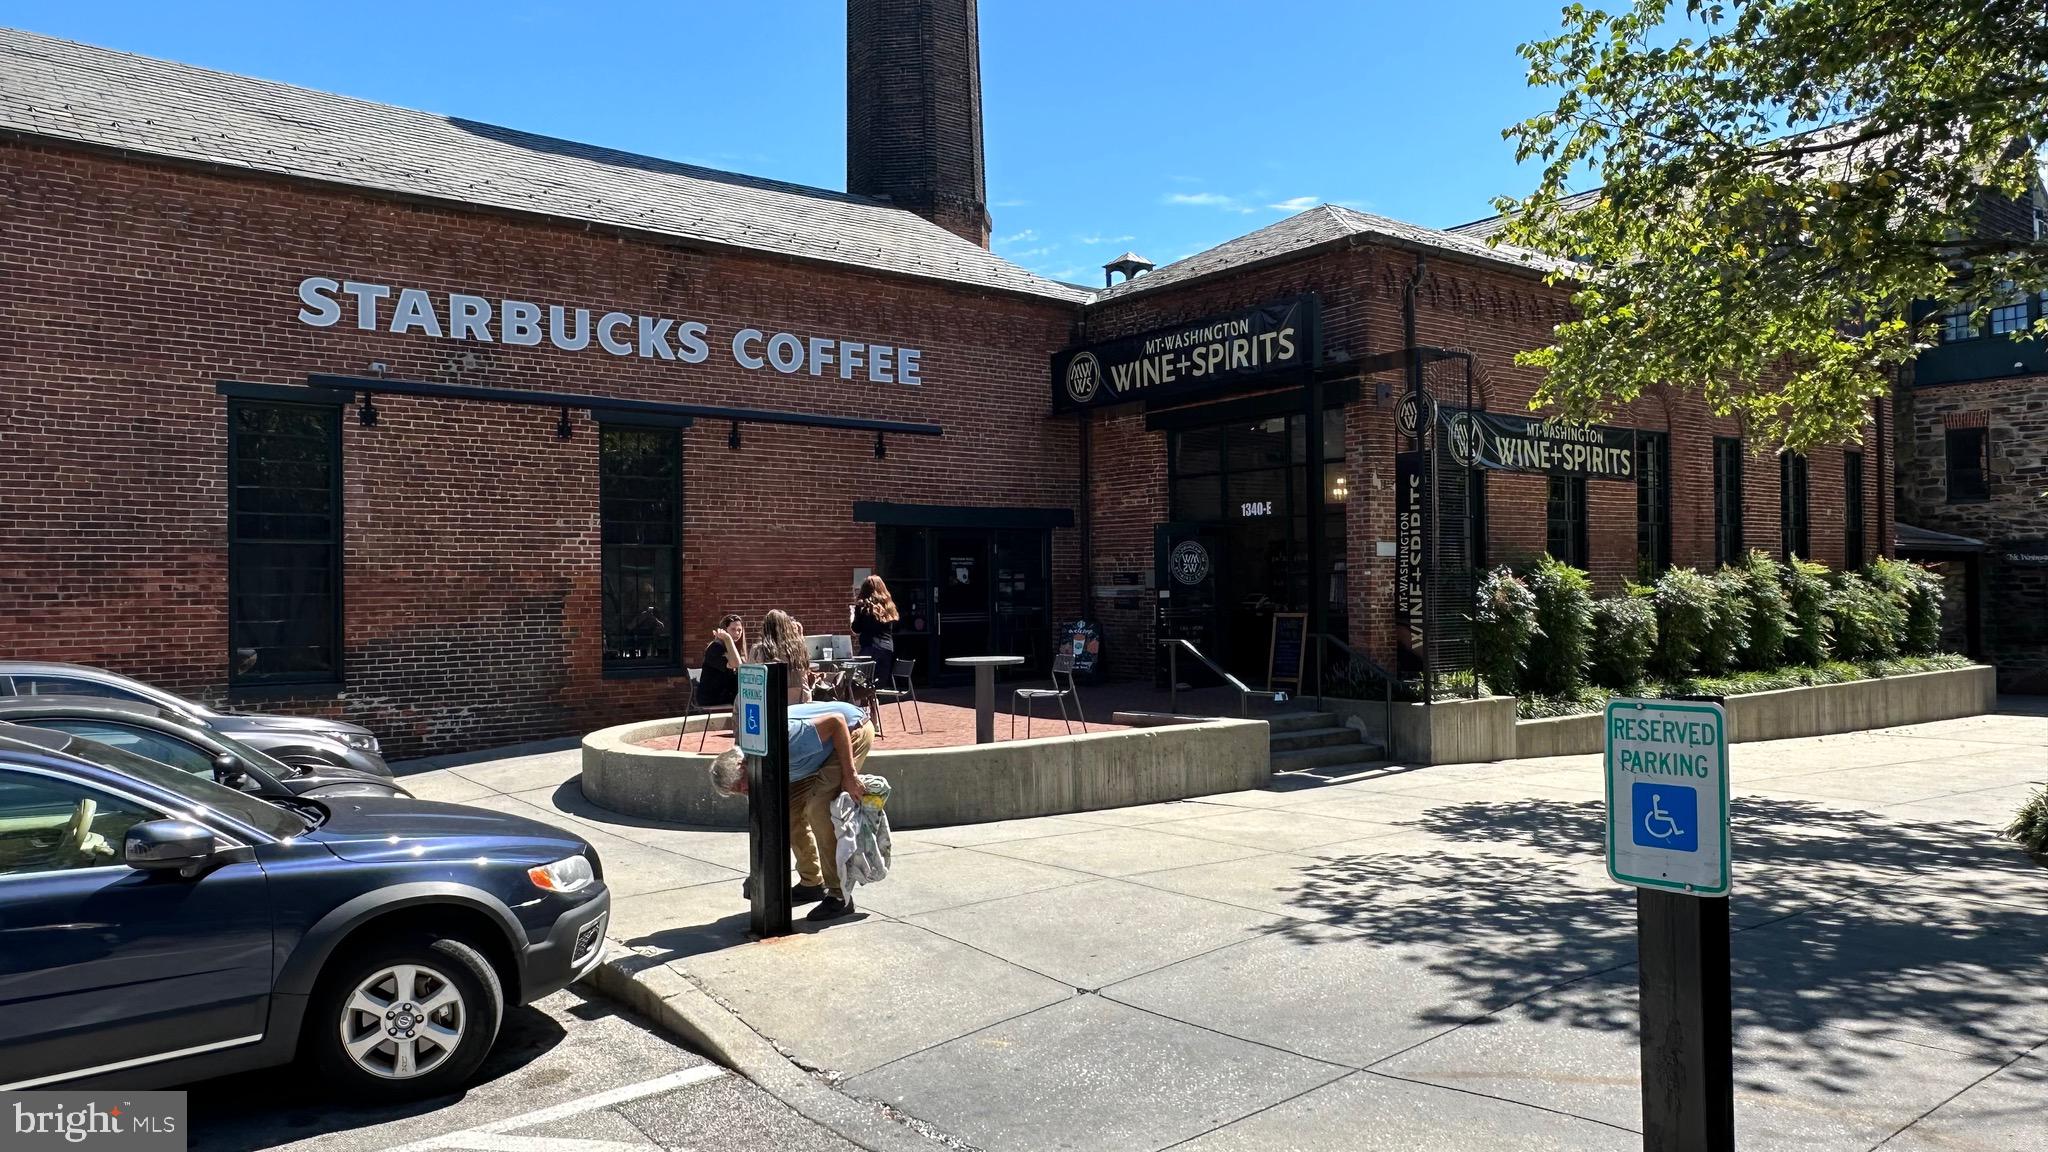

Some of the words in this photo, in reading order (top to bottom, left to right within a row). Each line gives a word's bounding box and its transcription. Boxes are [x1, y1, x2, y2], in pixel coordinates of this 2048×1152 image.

[297, 277, 710, 364] STARBUCKS
[731, 328, 922, 386] COFFEE
[1110, 328, 1295, 393] WINE+SPIRITS
[1495, 436, 1631, 476] WINE+SPIRITS
[742, 688, 763, 700] PARKING
[1614, 717, 1716, 746] RESERVED
[1620, 749, 1709, 779] PARKING
